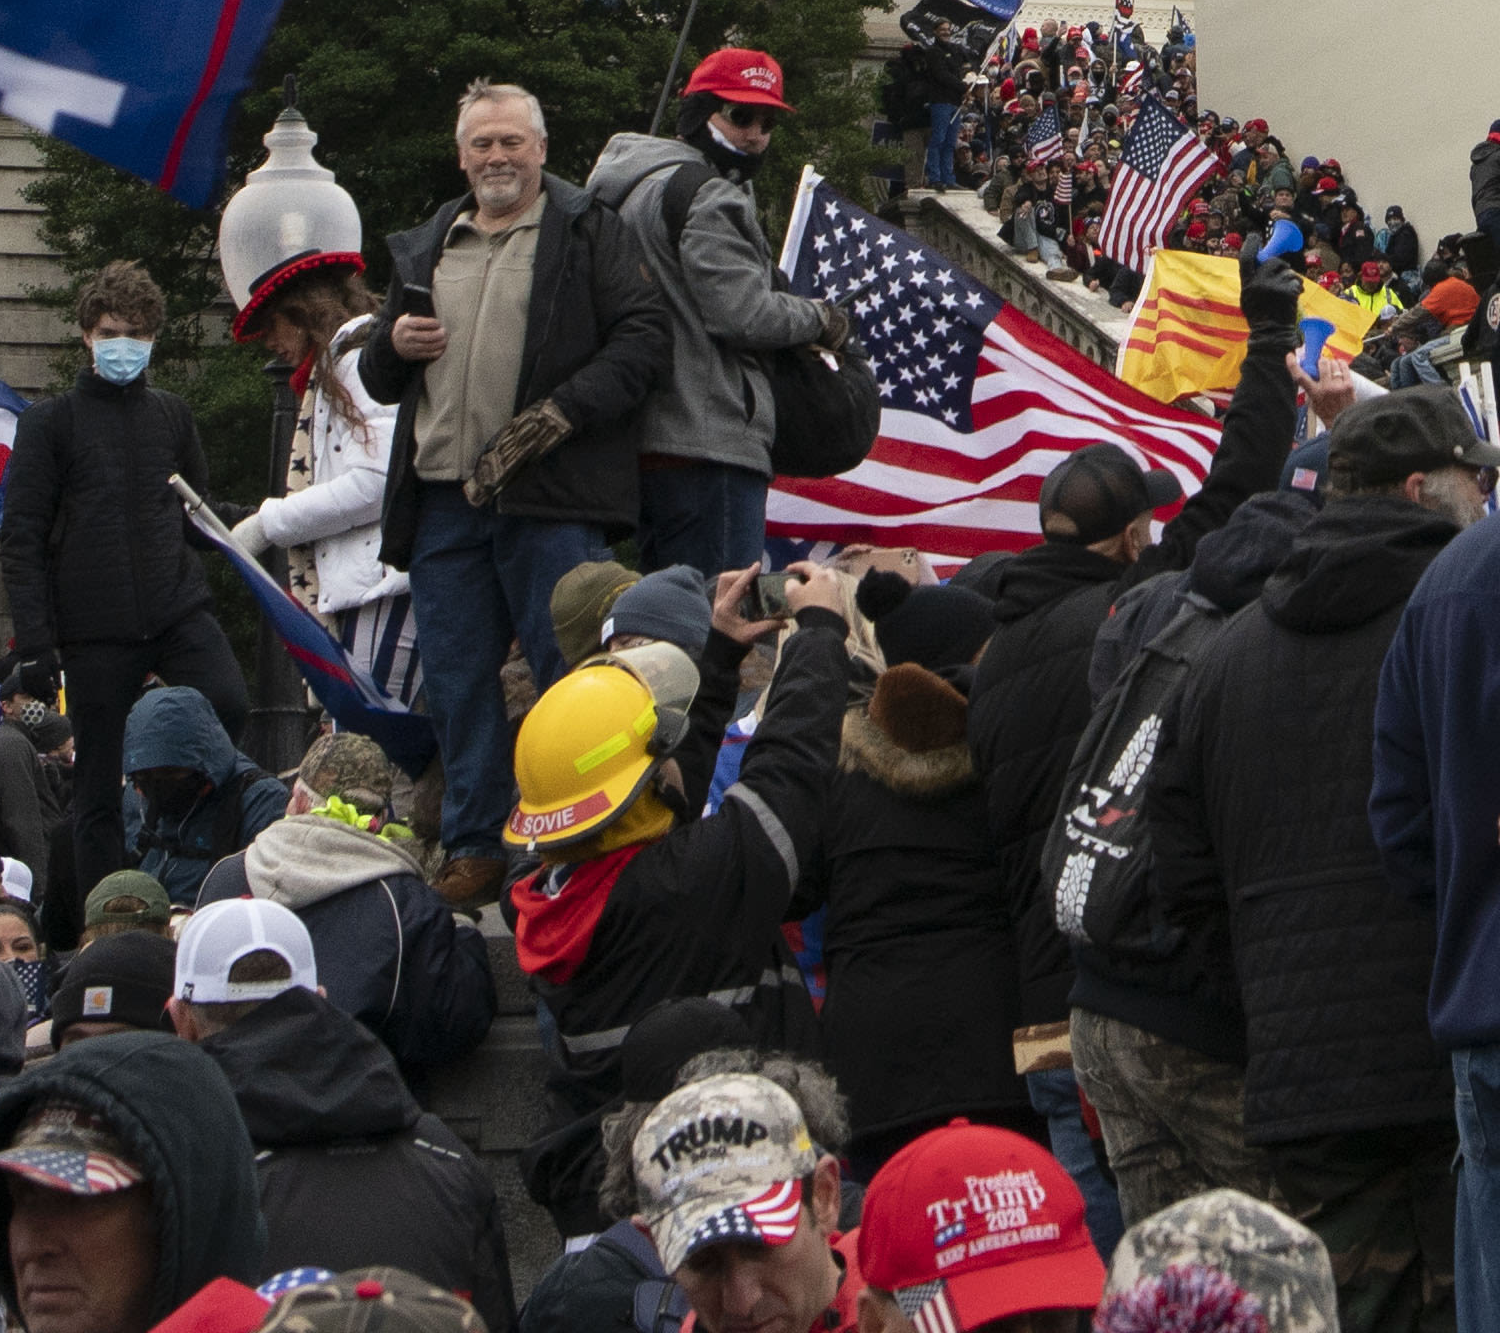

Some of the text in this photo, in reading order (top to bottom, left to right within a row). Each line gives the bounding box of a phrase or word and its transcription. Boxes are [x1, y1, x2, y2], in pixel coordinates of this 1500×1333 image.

[522, 805, 576, 835] SOVIE
[649, 1116, 769, 1172] TRUMP
[964, 1169, 1040, 1198] President
[926, 1184, 1047, 1231] Trump
[985, 1206, 1029, 1233] 2020
[968, 1228, 1022, 1258] AMERICA
